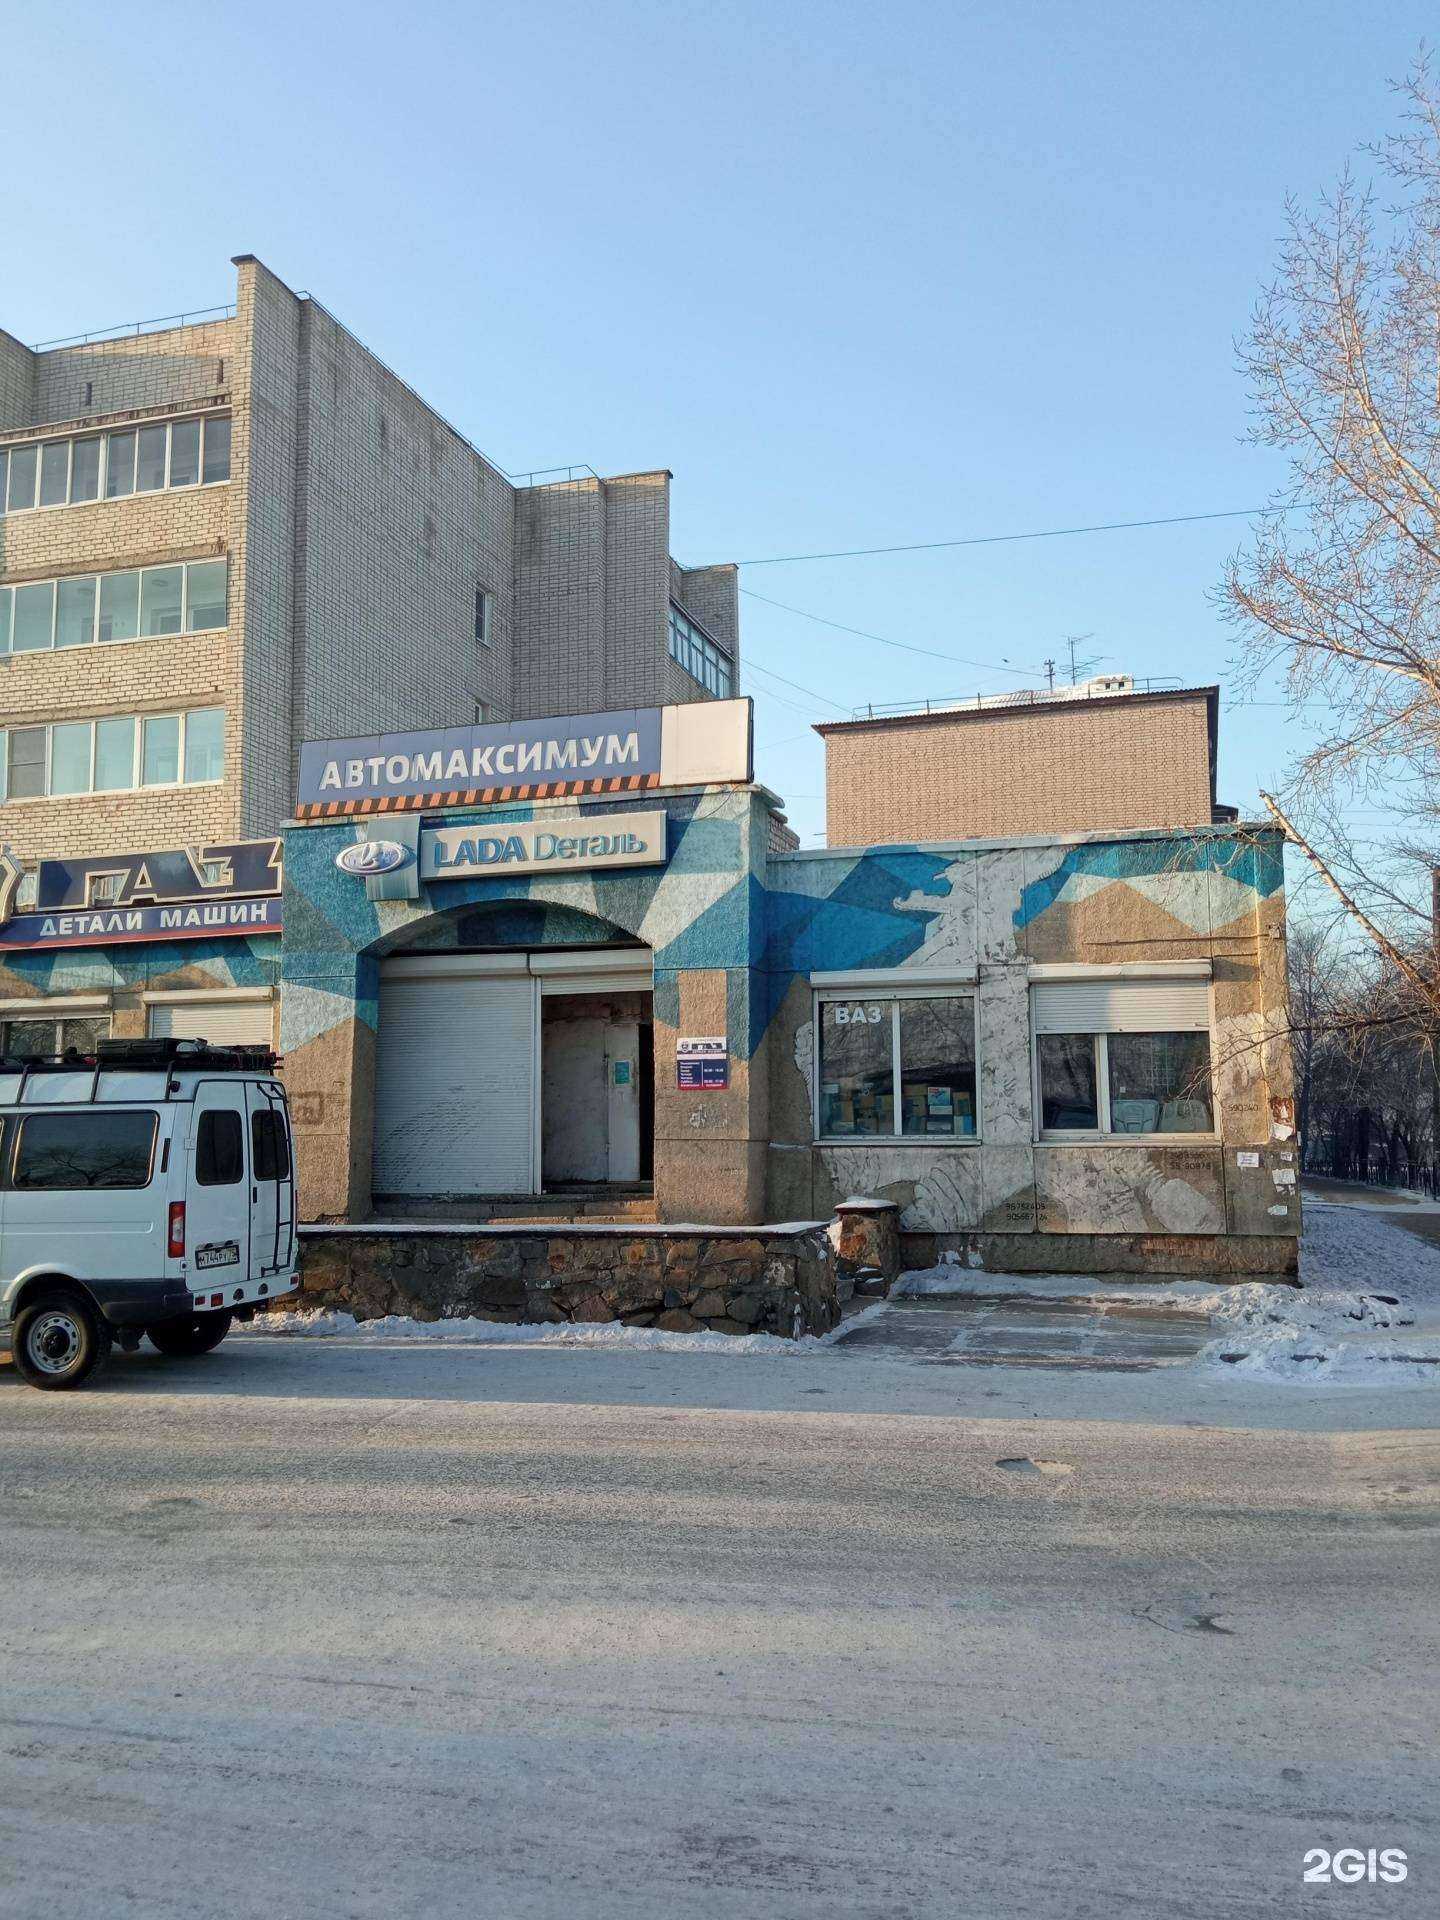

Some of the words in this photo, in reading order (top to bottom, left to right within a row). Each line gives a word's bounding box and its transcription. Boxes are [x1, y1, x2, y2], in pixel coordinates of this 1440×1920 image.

[319, 732, 640, 791] АВТОМАКСИМУМ
[433, 835, 529, 868] LADA
[37, 838, 283, 911] ГАЗ
[40, 911, 143, 937] ДЕТАЛИ
[159, 903, 268, 929] МАШИН
[835, 1006, 882, 1024] ВАЗ
